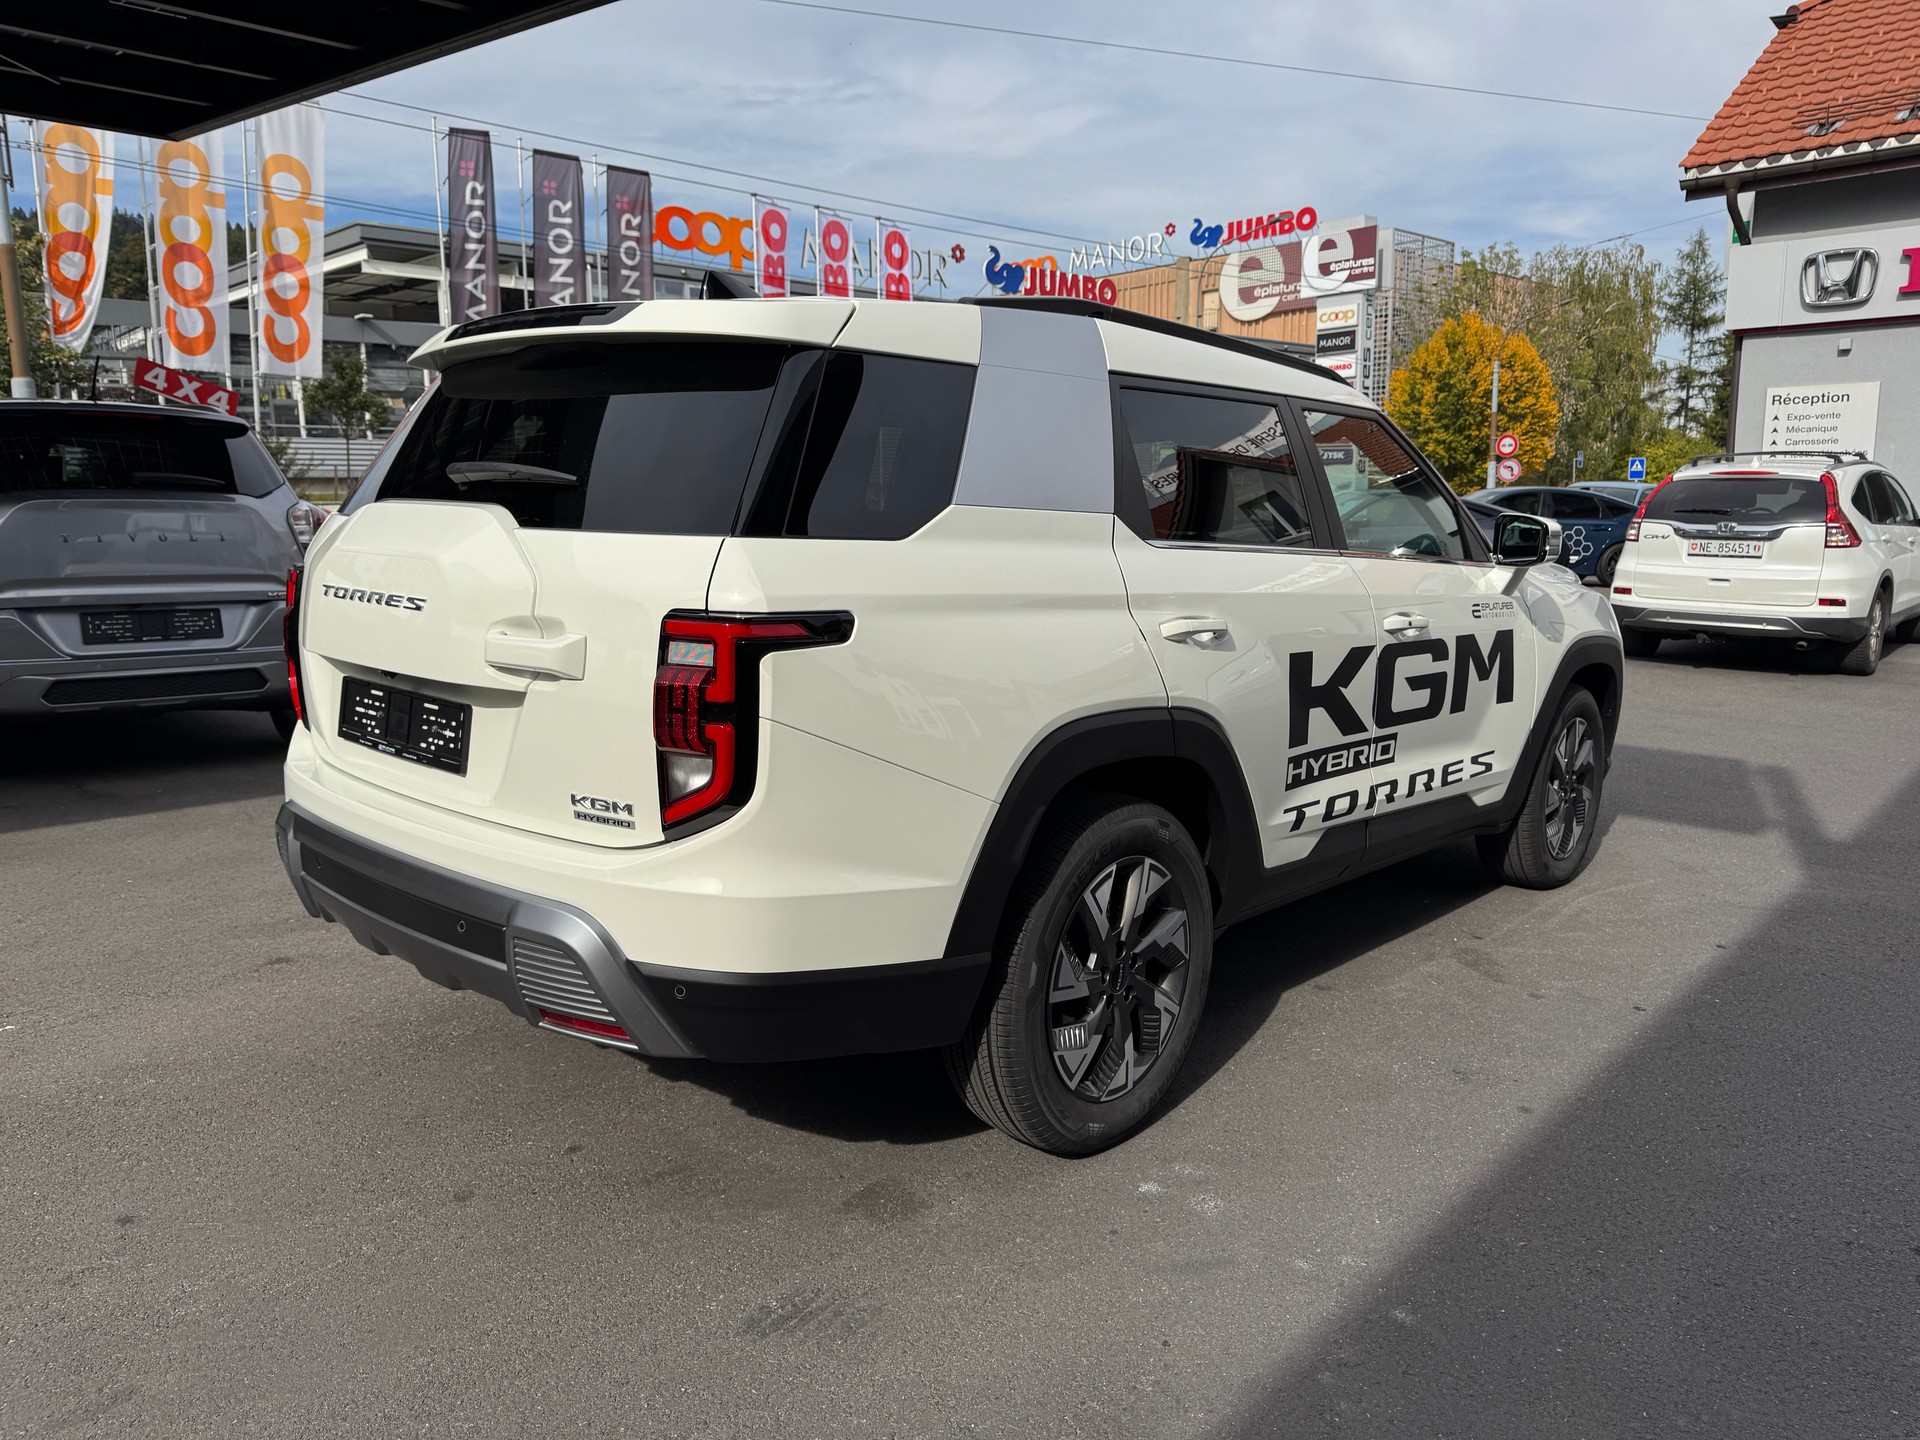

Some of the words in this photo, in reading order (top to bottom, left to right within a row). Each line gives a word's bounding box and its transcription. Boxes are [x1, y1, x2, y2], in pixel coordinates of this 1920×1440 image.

[44, 123, 113, 335] coop
[652, 205, 755, 271] oop
[1222, 206, 1317, 245] JUMBO
[157, 140, 225, 356] coop
[262, 153, 324, 363] coop
[548, 199, 574, 305] ANOR
[619, 212, 642, 297] NOR
[1068, 232, 1165, 273] MANOR
[1351, 266, 1375, 275] centre
[1022, 266, 1117, 306] JUMBO
[1319, 309, 1355, 323] coop
[1319, 336, 1351, 348] MANOR
[1771, 391, 1851, 407] Réception
[1785, 424, 1839, 436] Mécanique
[1786, 411, 1841, 423] Expo-vente
[1784, 436, 1840, 447] Carrosserie
[59, 532, 227, 543] TIVOLI
[1643, 533, 1672, 541] CR-V
[321, 583, 428, 613] TORRES
[1481, 601, 1514, 611] EPLATURES
[1288, 628, 1514, 750] KGM
[1286, 738, 1397, 786] HYBRID
[570, 792, 635, 818] KGM
[1282, 749, 1496, 833] TORRES
[577, 812, 632, 829] HYBRID
